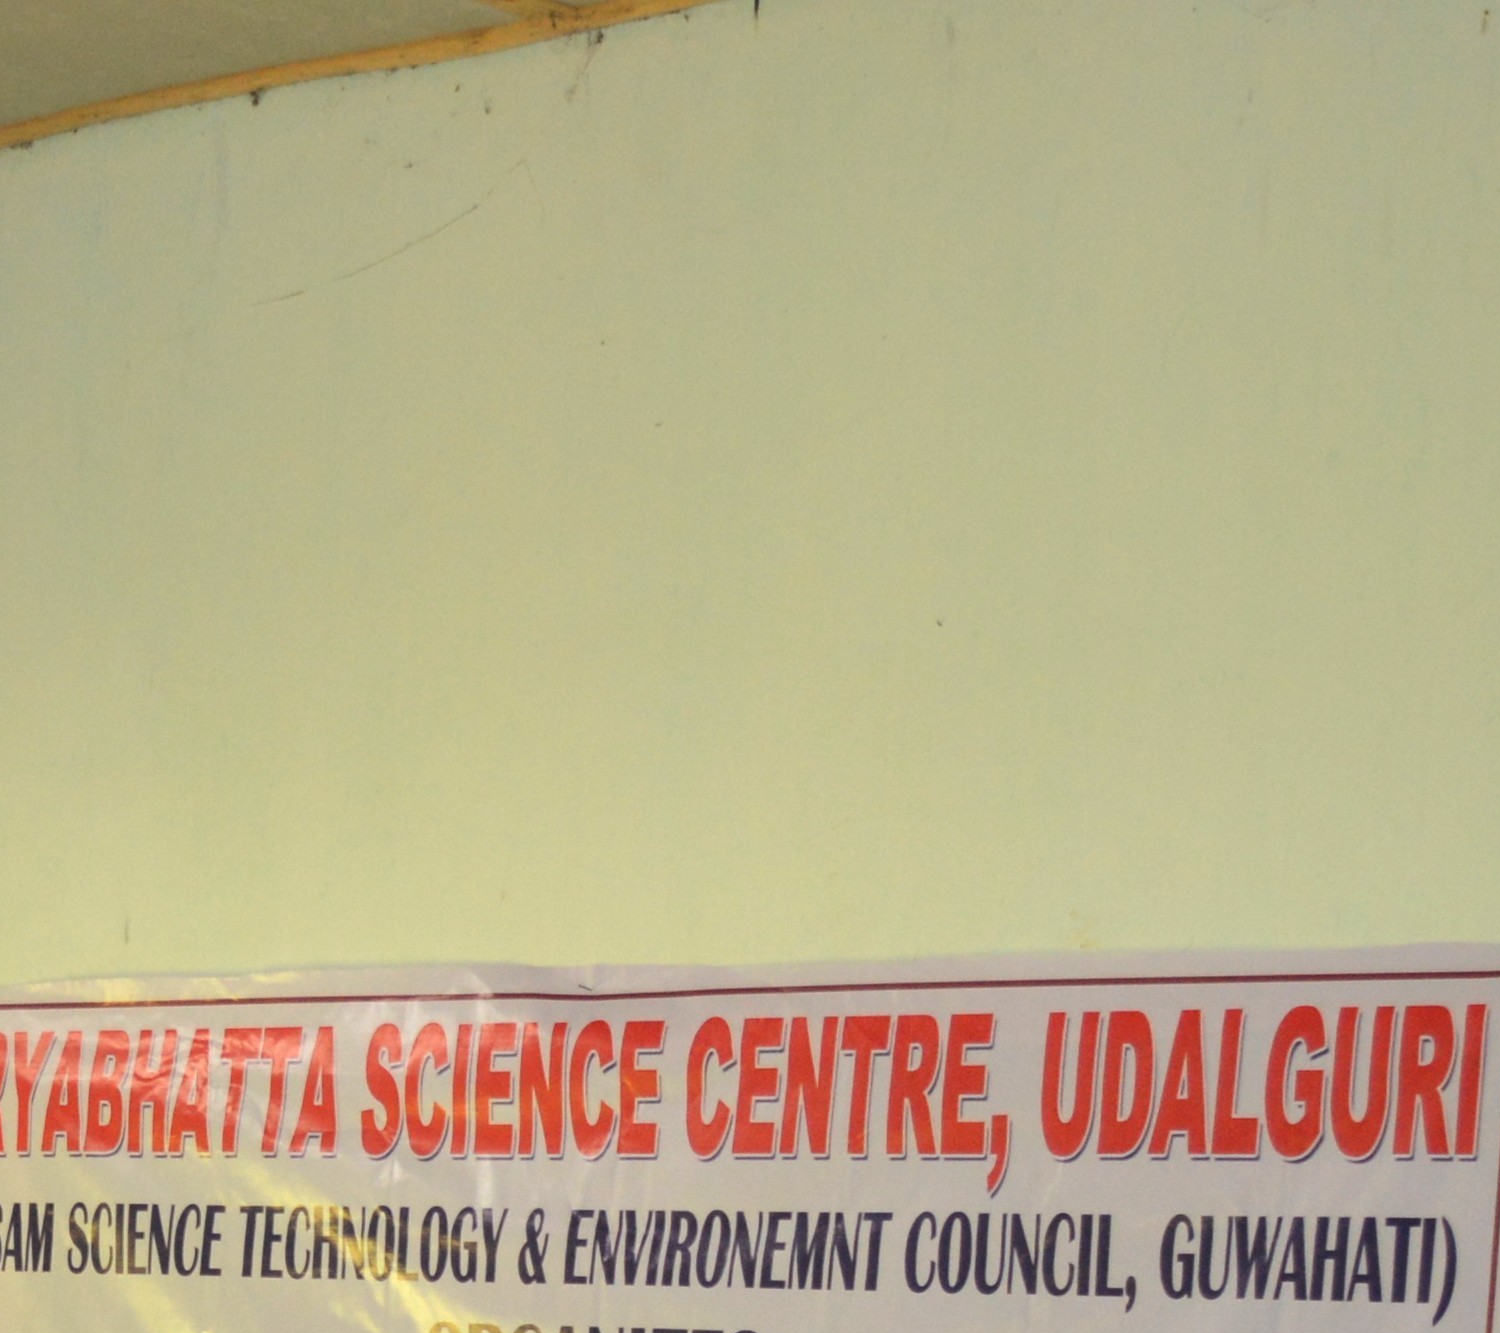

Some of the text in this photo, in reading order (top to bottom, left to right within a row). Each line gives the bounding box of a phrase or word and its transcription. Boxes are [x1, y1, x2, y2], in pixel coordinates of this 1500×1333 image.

[361, 1019, 666, 1159] SCIENCE
[686, 1012, 1009, 1195] CENTRE,
[1040, 1003, 1487, 1163] UDALGURI
[68, 1201, 226, 1277] SCIENCE
[239, 1204, 508, 1284] TECHNOLOGY
[518, 1208, 548, 1285] &
[564, 1207, 893, 1292] ENVIRONEMNT
[904, 1211, 1138, 1313] COUNCIL,
[1160, 1214, 1458, 1326] GUWAHATI)
